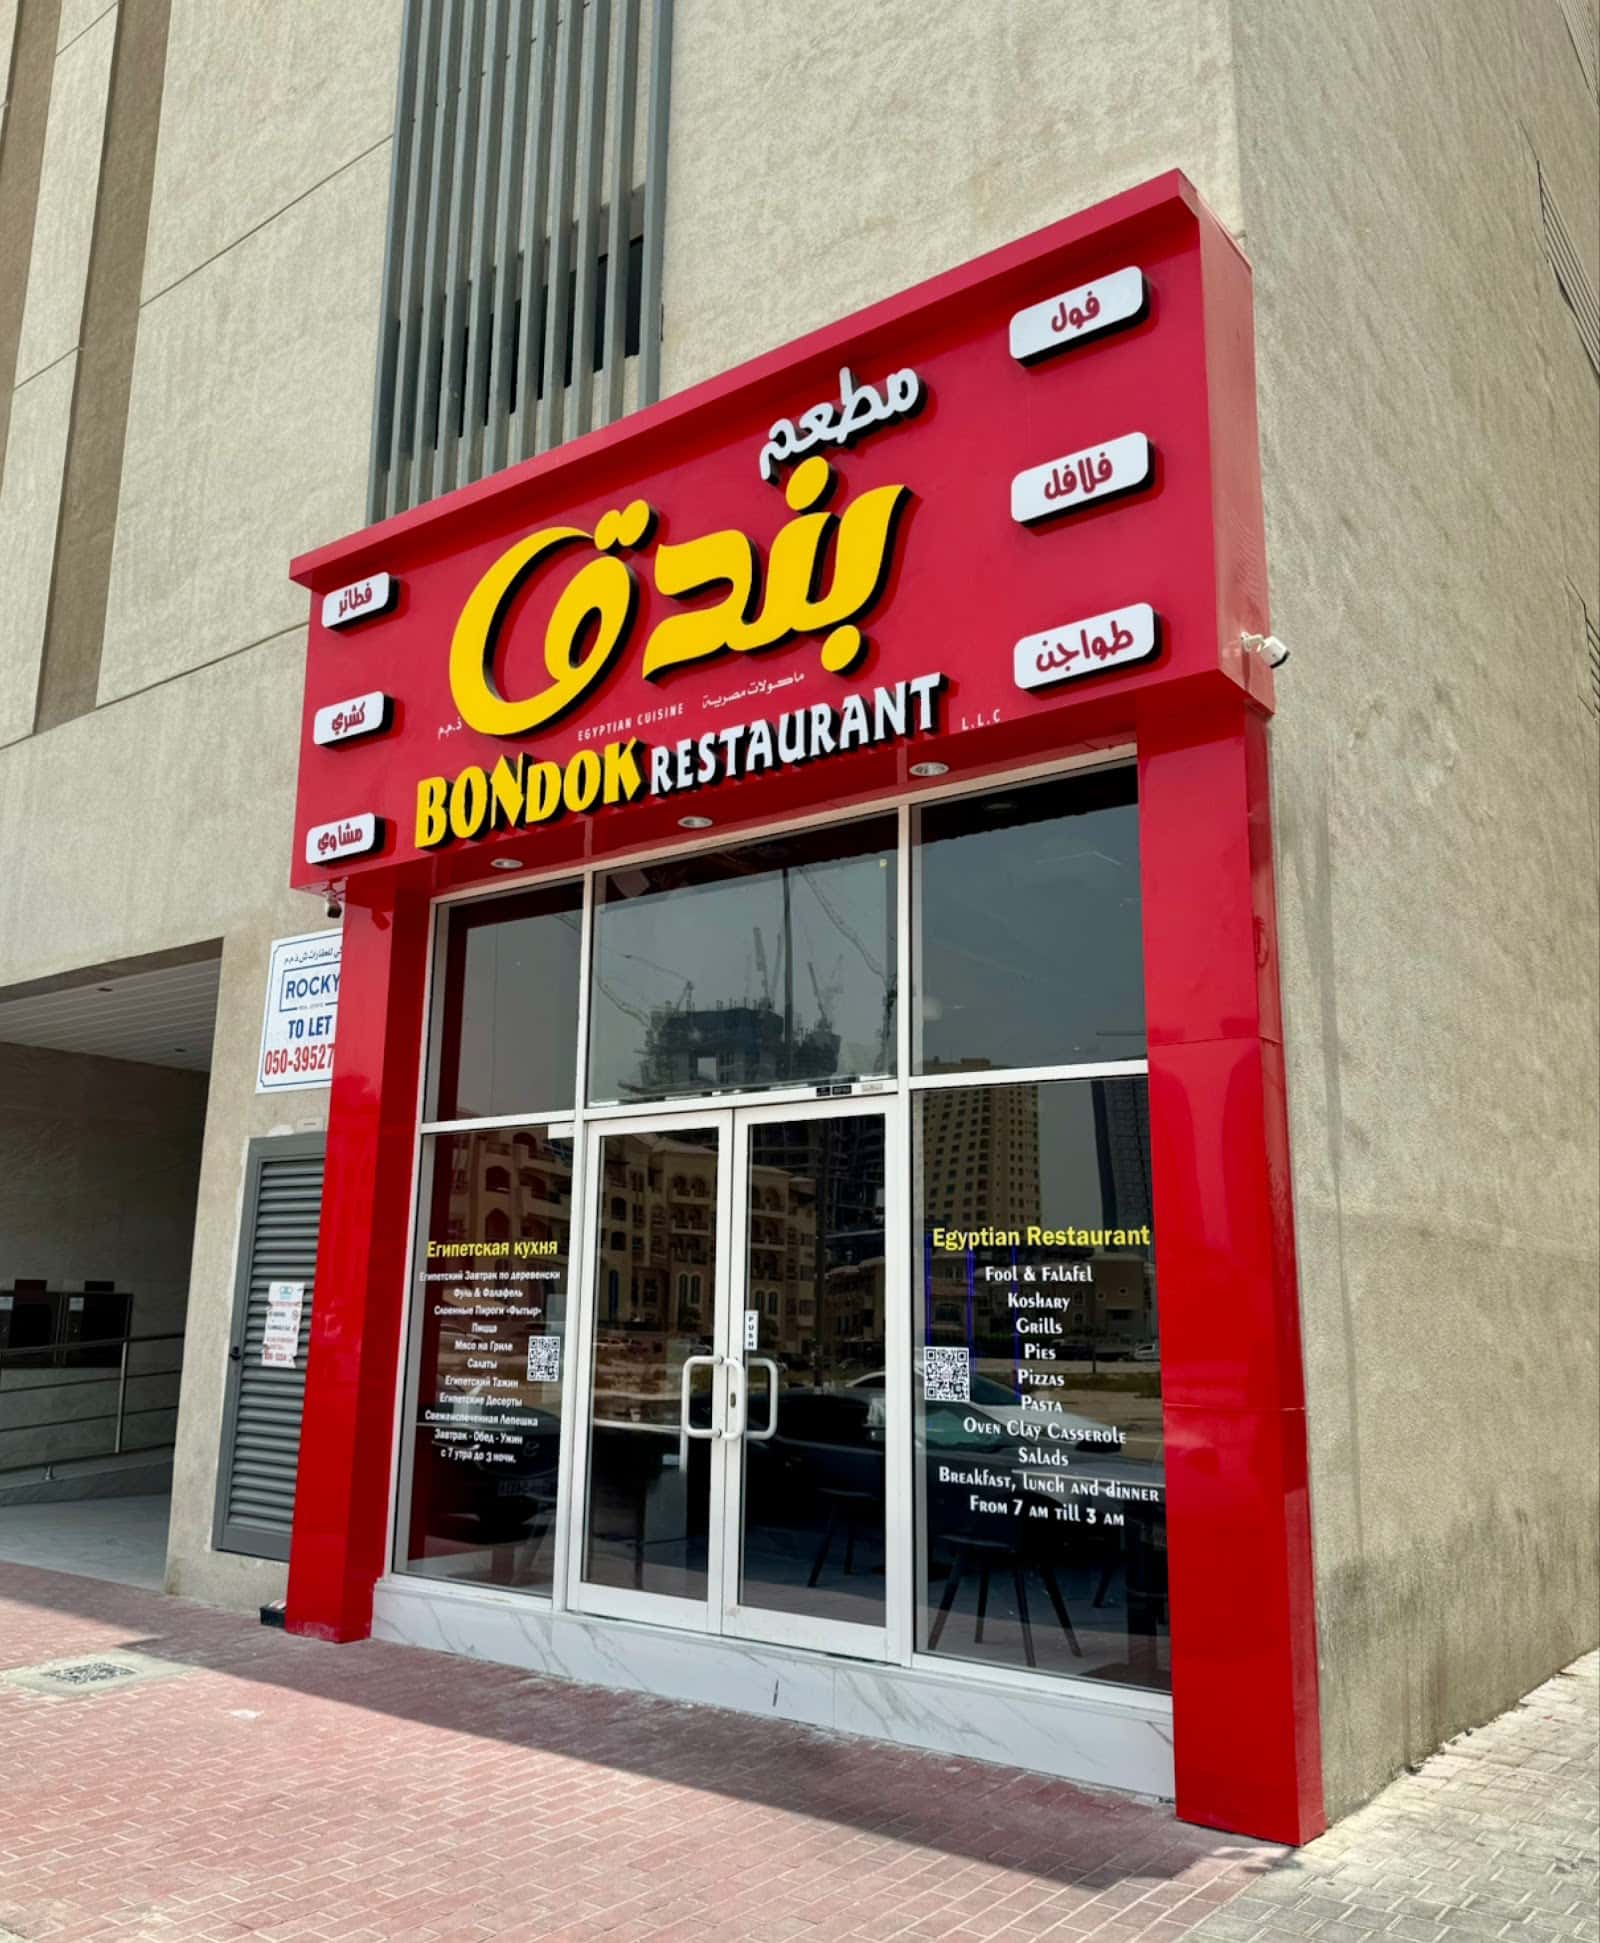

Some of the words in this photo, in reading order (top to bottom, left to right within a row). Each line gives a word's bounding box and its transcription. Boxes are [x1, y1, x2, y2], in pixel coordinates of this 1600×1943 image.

[1051, 291, 1100, 333] فول
[760, 367, 919, 480] مطعم
[1044, 452, 1113, 501] فلافل
[338, 582, 373, 618] فطائر
[449, 456, 905, 736] بندق
[1035, 620, 1134, 672] طواجن
[332, 702, 366, 735] كشري
[578, 718, 632, 741] EGYPTIAN
[637, 703, 684, 725] CUISINE
[415, 736, 640, 848] BONDOK
[651, 673, 942, 795] RESTAURANT
[317, 823, 363, 855] مشاوي
[285, 973, 341, 1000] ROCKY
[288, 1018, 304, 1039] TO
[308, 1015, 333, 1037] LET
[427, 1241, 510, 1258] Египетская
[514, 1240, 558, 1259] кухня
[933, 1228, 1020, 1250] Egyptian
[1027, 1226, 1150, 1246] Restaurant
[420, 1270, 463, 1281] Египетский
[464, 1270, 497, 1281] Завтрак
[985, 1266, 1018, 1282] Fool
[1023, 1267, 1036, 1281] &
[1042, 1266, 1093, 1282] Falafel
[1008, 1292, 1070, 1312] Koshary
[1016, 1317, 1063, 1334] Grills
[1024, 1343, 1056, 1360] Pies
[1017, 1369, 1065, 1387] Pizzas
[963, 1417, 1001, 1435] Oven
[1006, 1419, 1041, 1440] Clay
[1047, 1423, 1128, 1444] Casserole
[447, 1447, 453, 1458] 7
[486, 1451, 492, 1462] 3
[1018, 1447, 1069, 1466] Salads
[1023, 1473, 1064, 1494] lunch
[969, 1495, 1008, 1515] From
[1013, 1499, 1023, 1516] 7
[1086, 1507, 1097, 1525] 3
